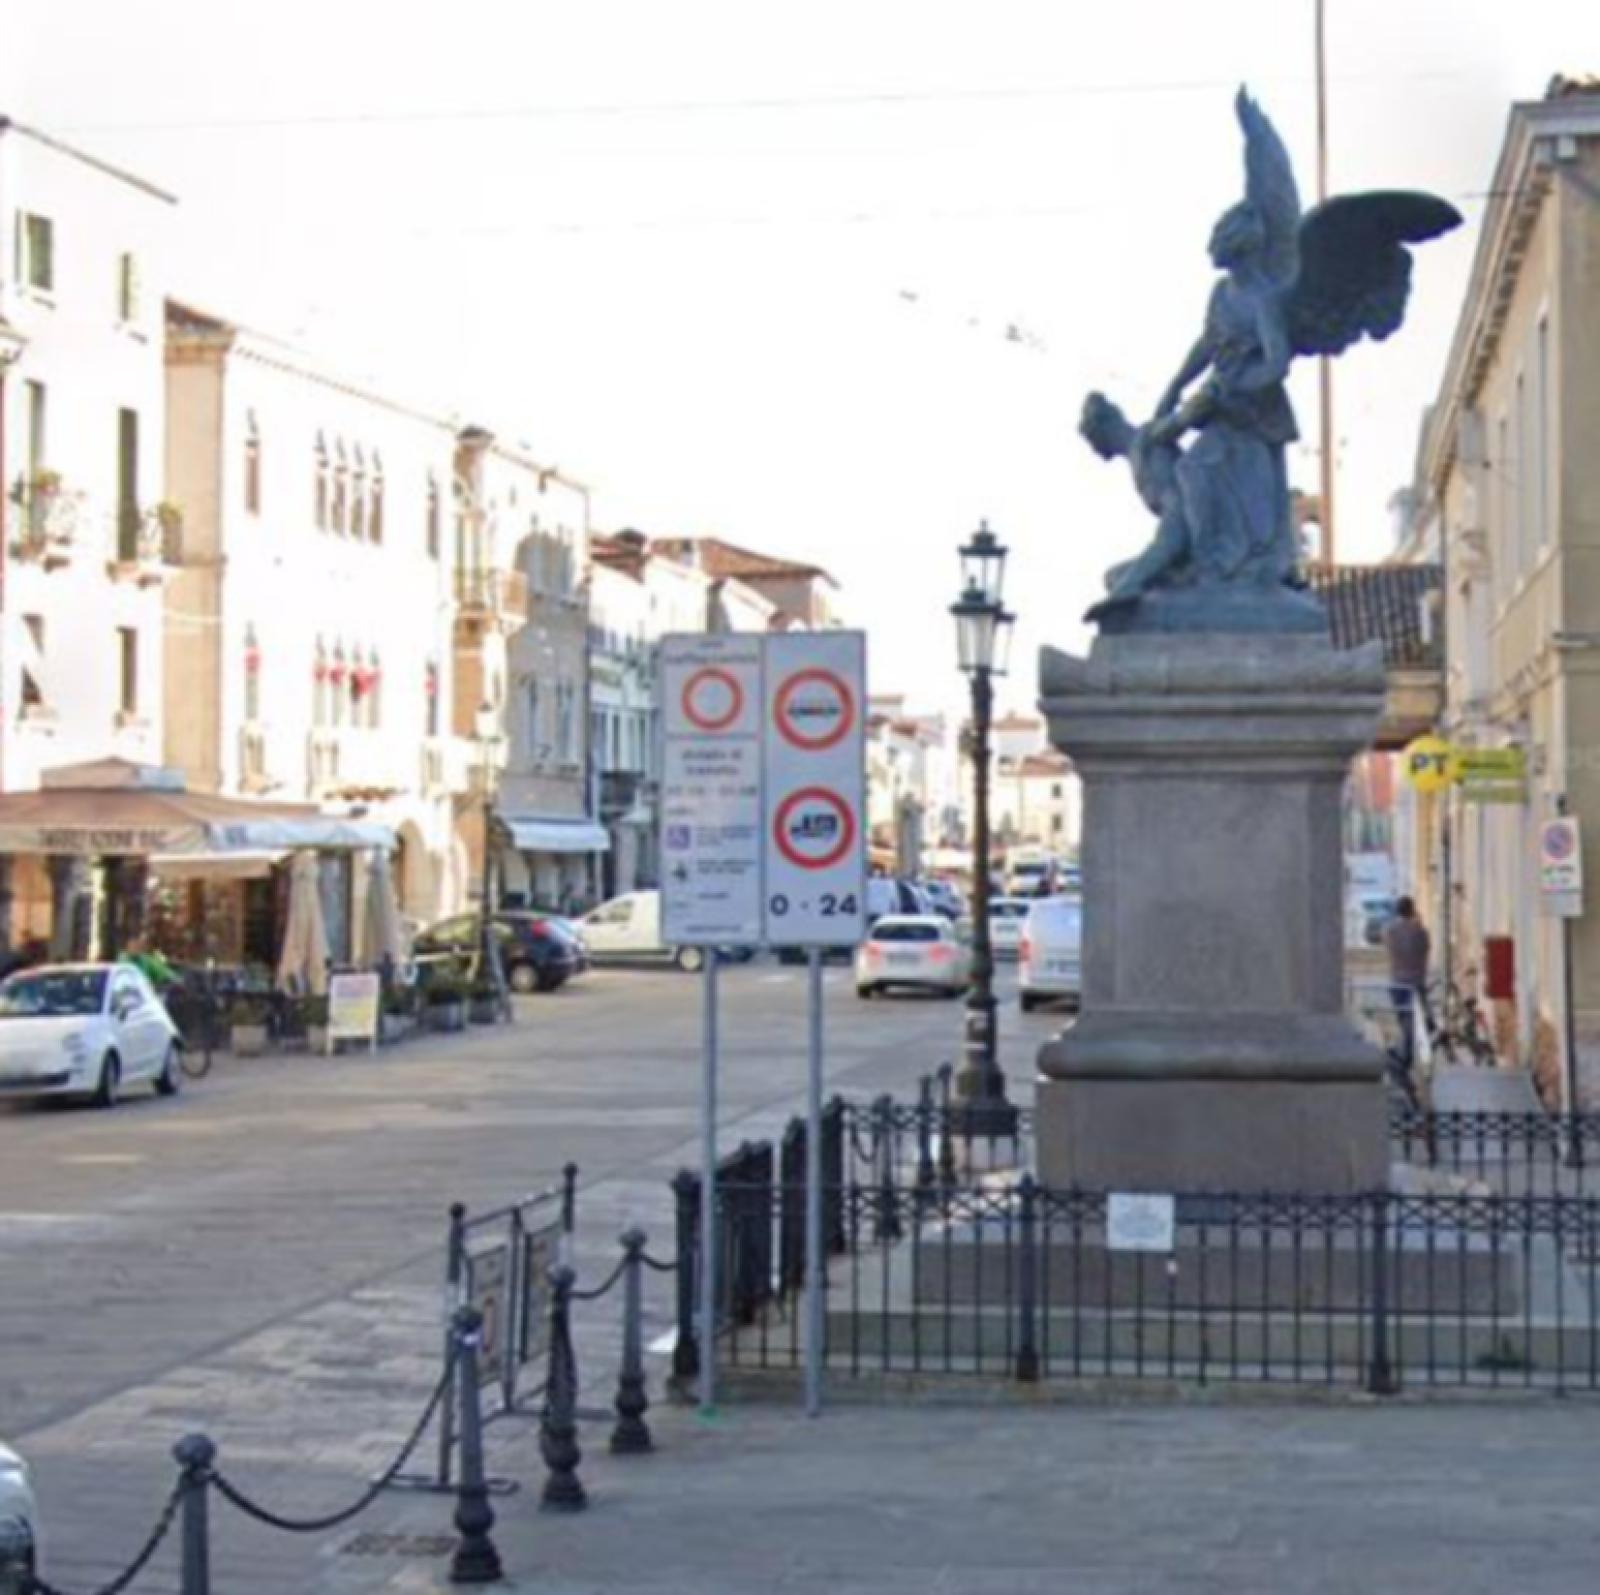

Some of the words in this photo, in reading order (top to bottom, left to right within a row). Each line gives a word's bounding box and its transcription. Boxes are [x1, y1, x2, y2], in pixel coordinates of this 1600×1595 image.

[1410, 753, 1447, 775] PT
[770, 894, 789, 916] 0
[820, 894, 857, 916] 24
